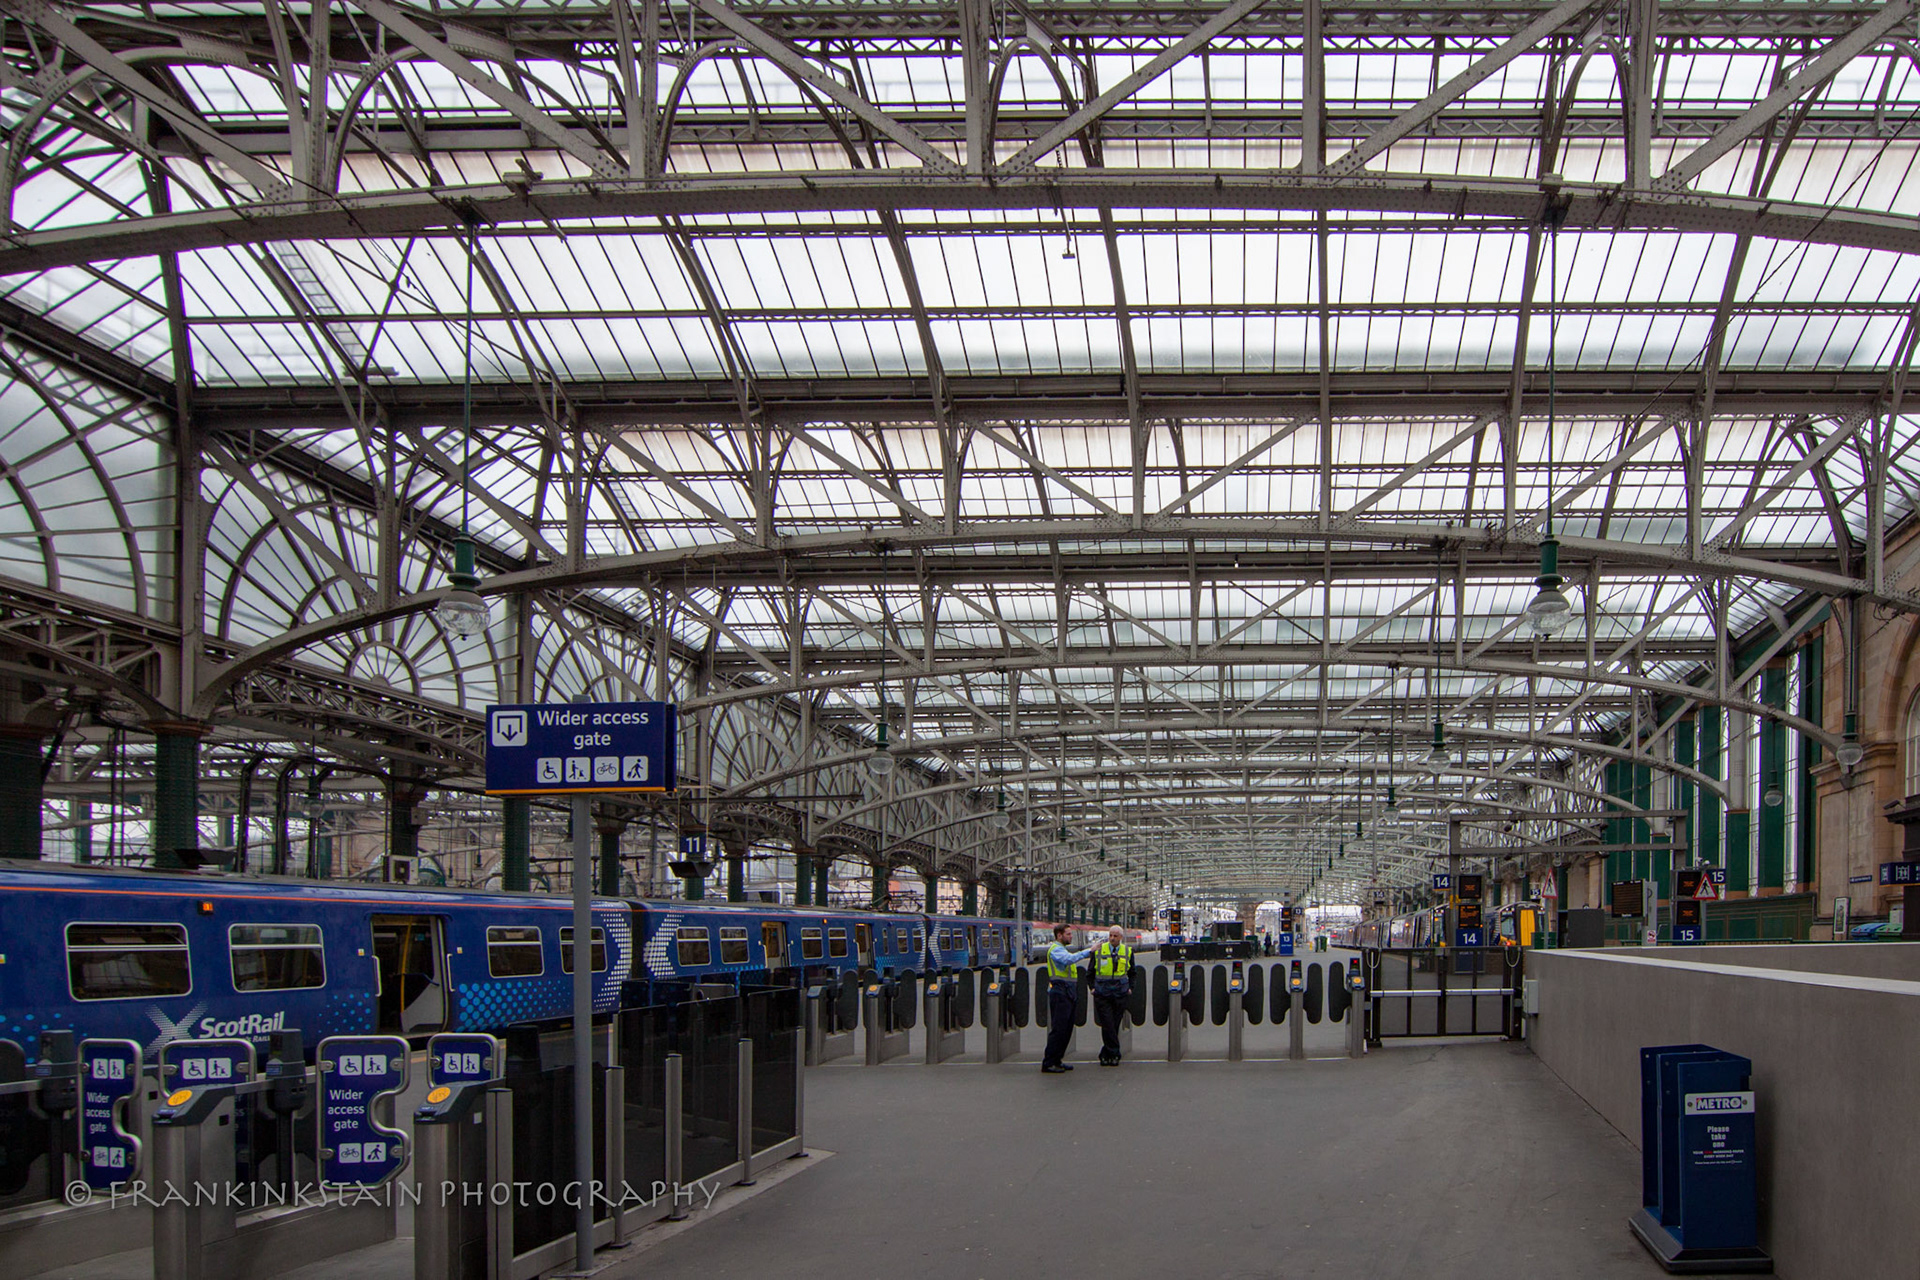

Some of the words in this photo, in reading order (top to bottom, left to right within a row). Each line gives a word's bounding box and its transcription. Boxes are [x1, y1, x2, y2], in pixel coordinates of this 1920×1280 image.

[537, 710, 589, 726] Wider
[592, 710, 649, 725] access
[574, 732, 611, 750] gate
[685, 837, 701, 853] 11
[1435, 876, 1449, 888] 14
[1712, 871, 1725, 883] 15
[1462, 933, 1477, 945] 14
[1680, 930, 1694, 941] 15
[199, 1010, 285, 1039] ScotRail
[86, 1092, 110, 1103] Wider
[330, 1089, 364, 1101] Wider
[1697, 1097, 1741, 1109] METRO
[86, 1109, 111, 1118] access
[328, 1105, 365, 1116] access
[90, 1123, 107, 1134] gate
[333, 1119, 359, 1131] gate
[1707, 1125, 1730, 1133] Please
[1711, 1133, 1726, 1141] take
